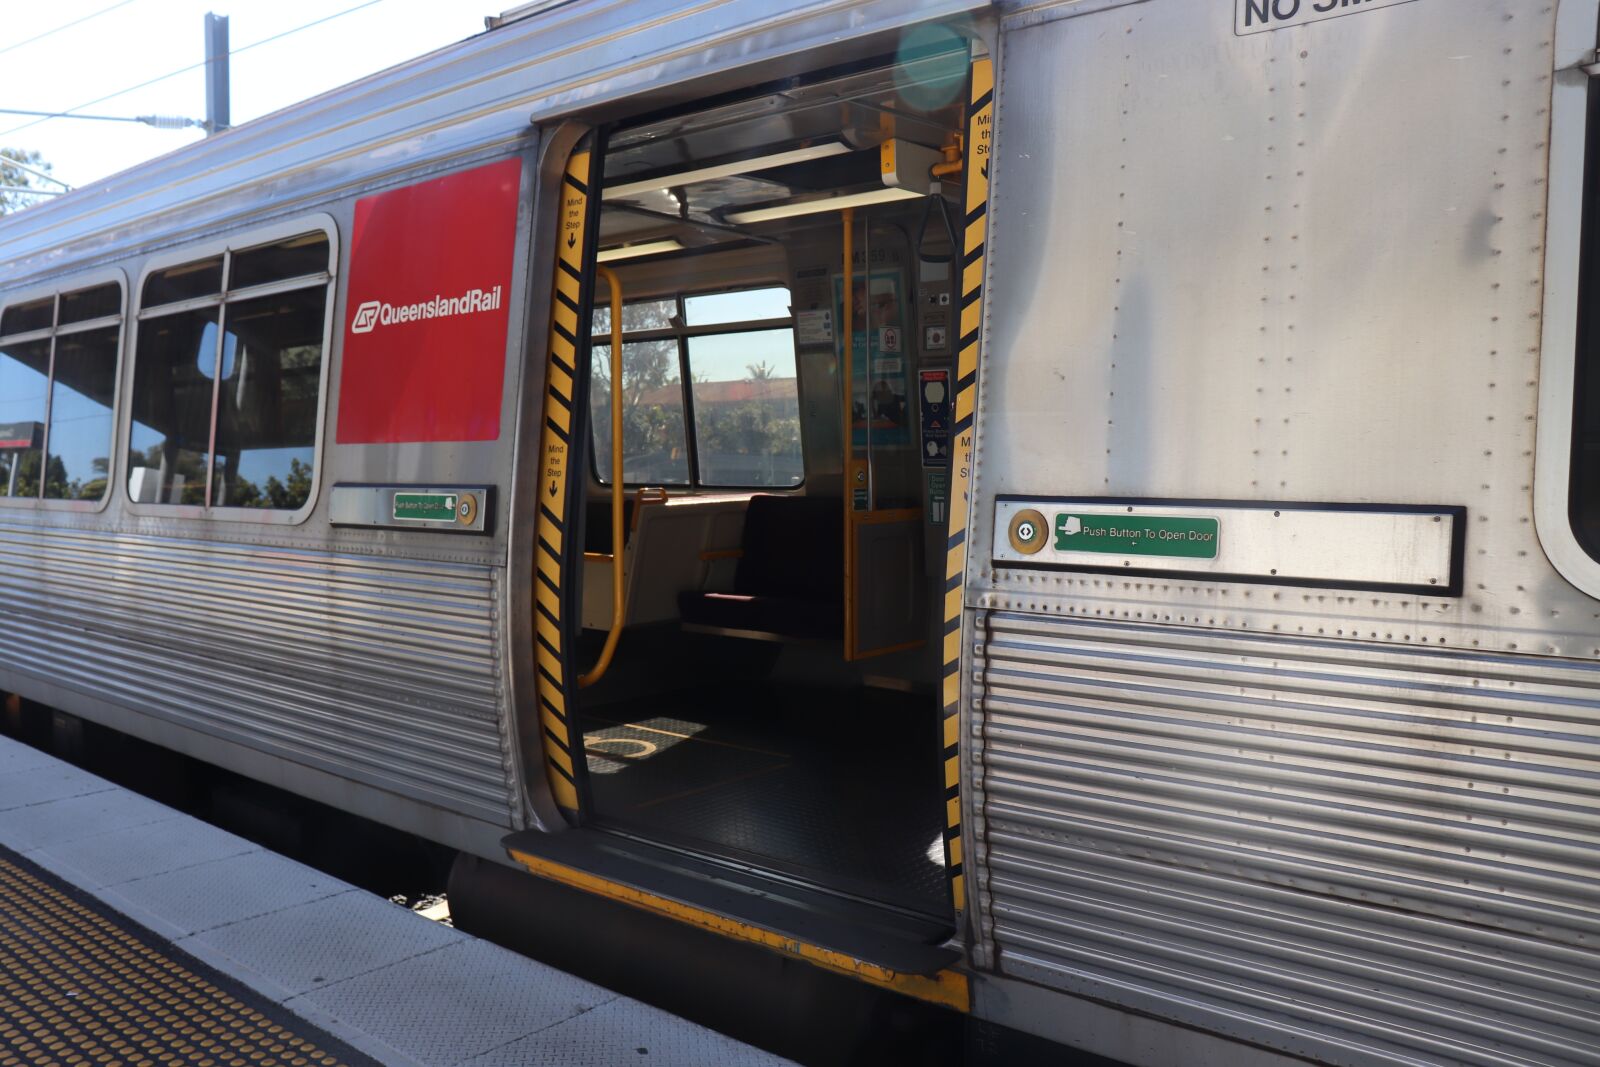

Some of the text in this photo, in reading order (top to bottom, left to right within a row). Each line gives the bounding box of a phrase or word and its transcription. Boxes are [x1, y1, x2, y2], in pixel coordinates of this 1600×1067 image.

[1244, 0, 1300, 27] NO
[977, 114, 992, 125] Mi
[981, 129, 991, 139] th
[977, 144, 990, 154] St
[567, 196, 583, 206] Mind
[565, 221, 580, 230] Step
[380, 285, 501, 325] QueenslandRail
[548, 445, 564, 453] Mind
[547, 469, 562, 477] Step
[1083, 526, 1214, 541] Push Button To Open Door
